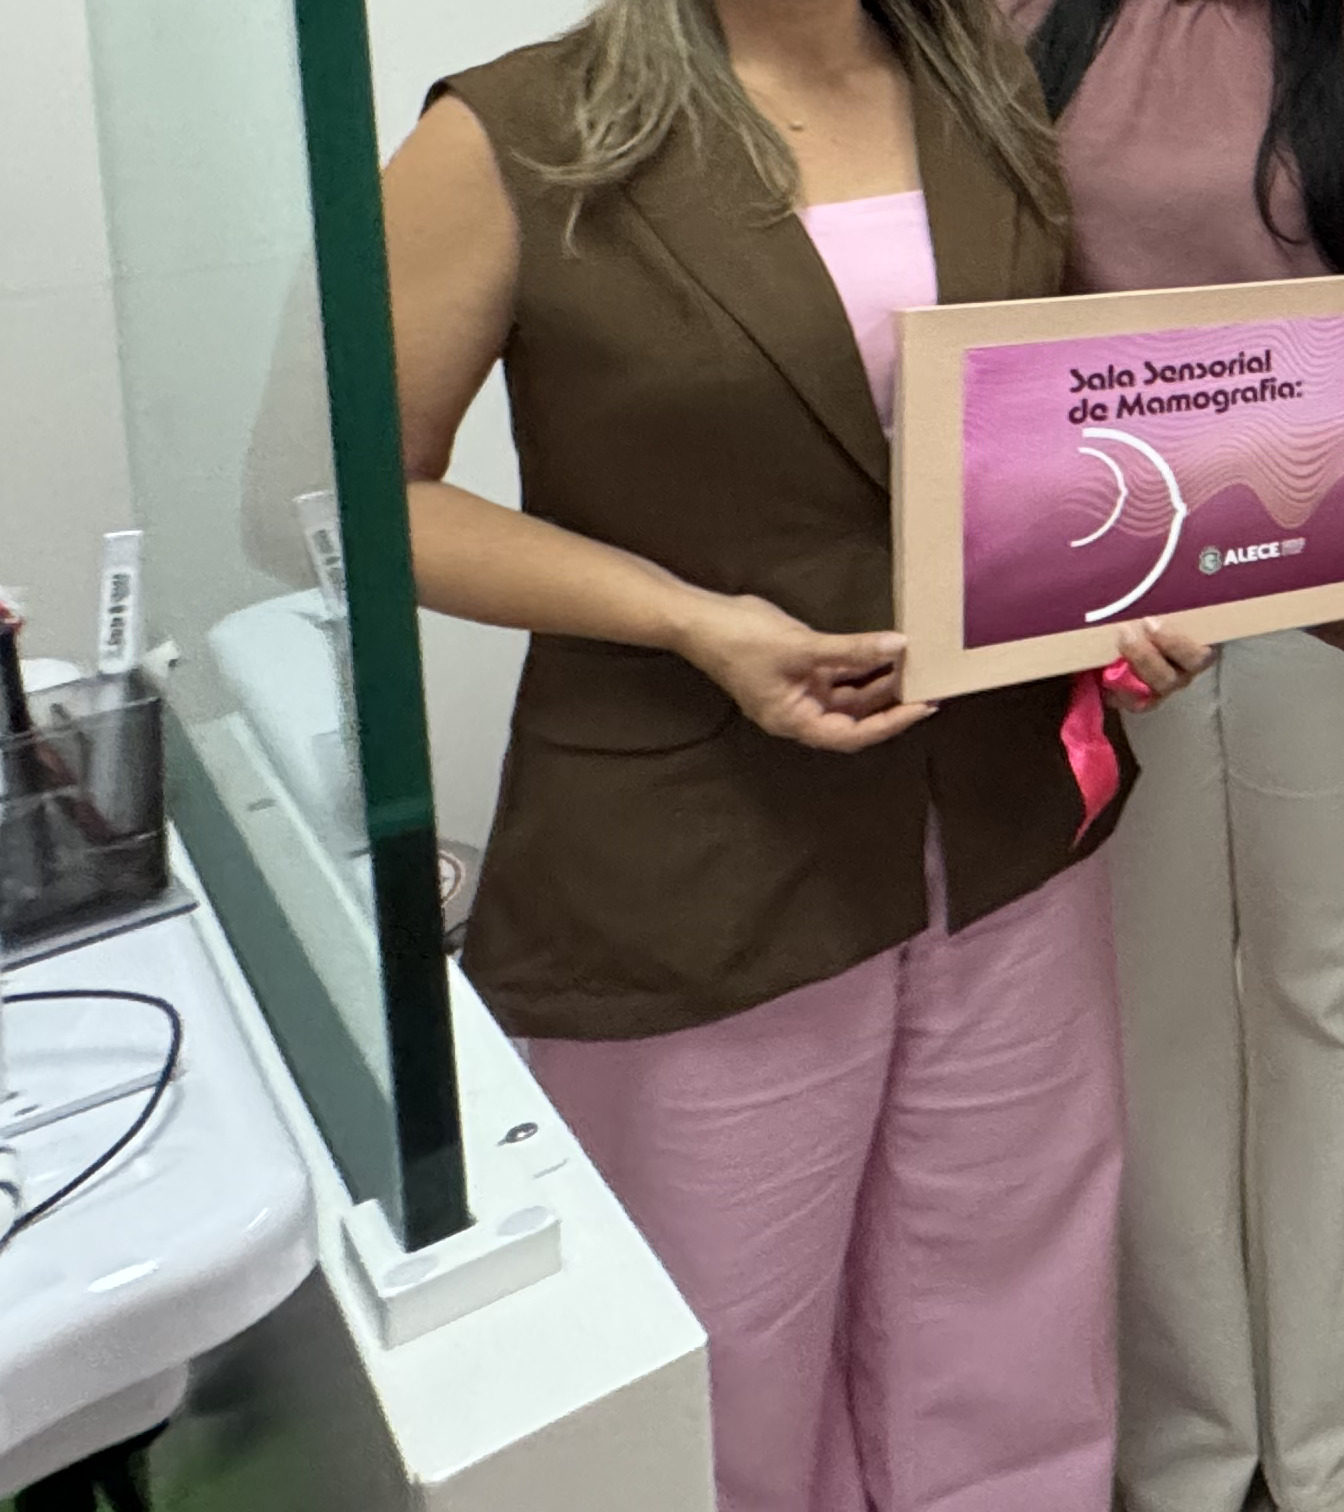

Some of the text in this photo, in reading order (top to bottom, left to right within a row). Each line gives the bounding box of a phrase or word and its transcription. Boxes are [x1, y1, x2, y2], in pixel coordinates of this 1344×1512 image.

[1069, 349, 1272, 393] Sala Sensorial
[1068, 398, 1108, 425] de
[1223, 541, 1281, 566] ALECE
